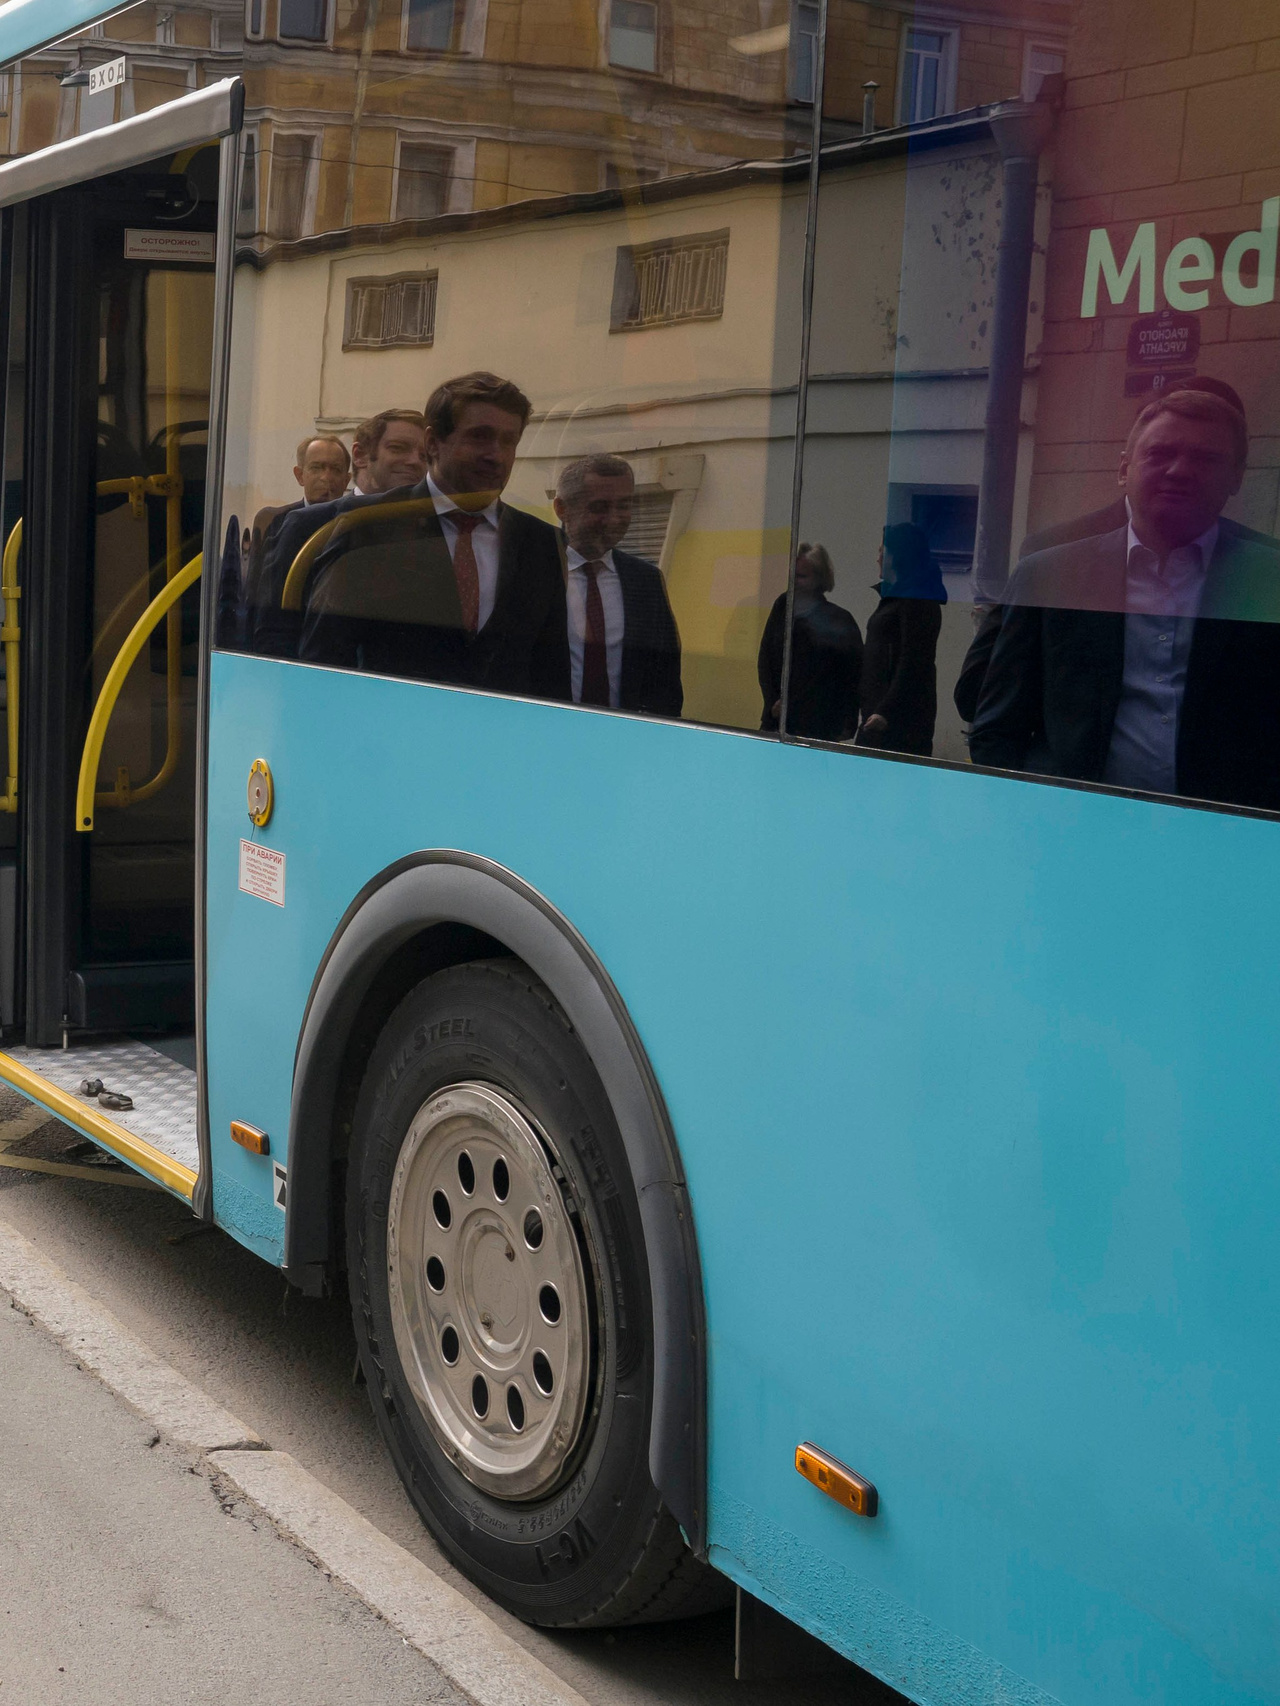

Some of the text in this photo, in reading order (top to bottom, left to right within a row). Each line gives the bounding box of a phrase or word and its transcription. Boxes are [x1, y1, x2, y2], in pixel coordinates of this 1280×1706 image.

[91, 62, 124, 90] ВХОД
[140, 237, 200, 247] ОСТОРОЖНО!
[1080, 195, 1280, 318] Med
[243, 844, 282, 865] ПРИ АВАРИИ
[413, 1017, 476, 1053] STEEL
